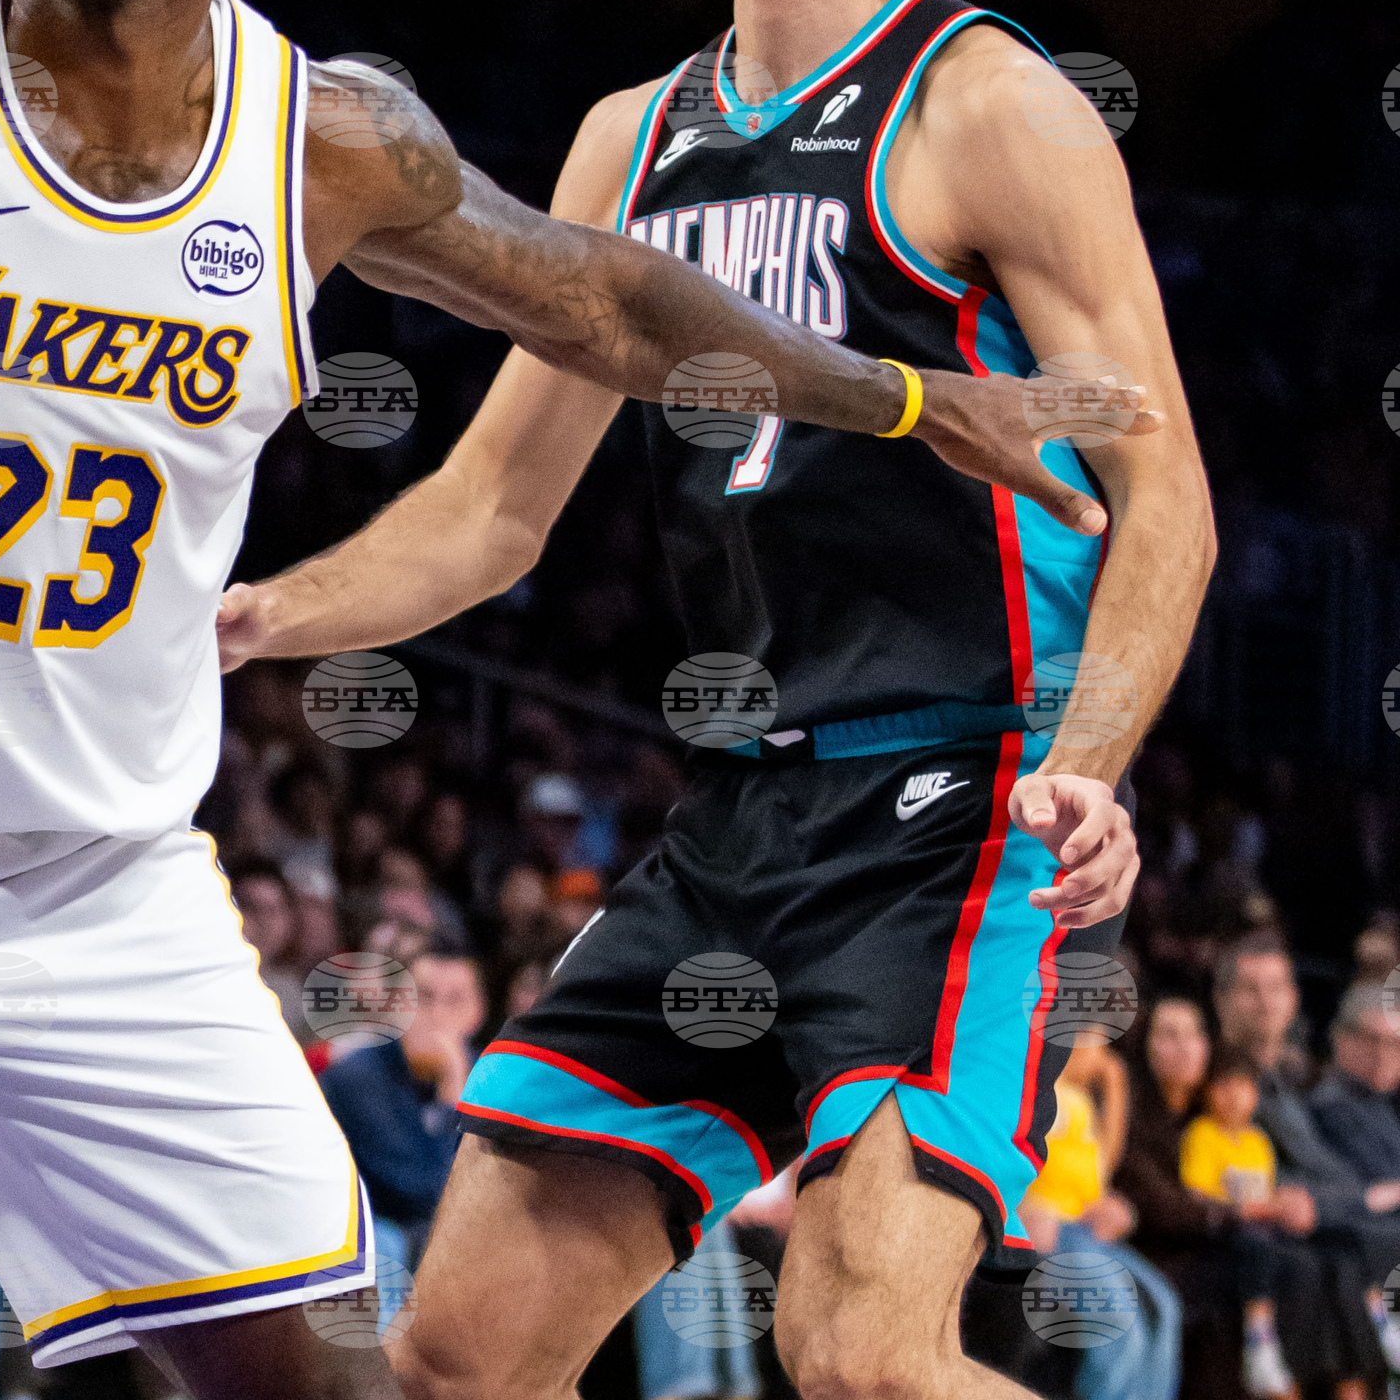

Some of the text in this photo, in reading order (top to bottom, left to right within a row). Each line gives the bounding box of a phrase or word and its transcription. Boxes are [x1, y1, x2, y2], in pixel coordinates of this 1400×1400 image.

[790, 136, 861, 152] Robinhood
[190, 238, 259, 276] bibigo
[902, 771, 952, 803] NIKE
